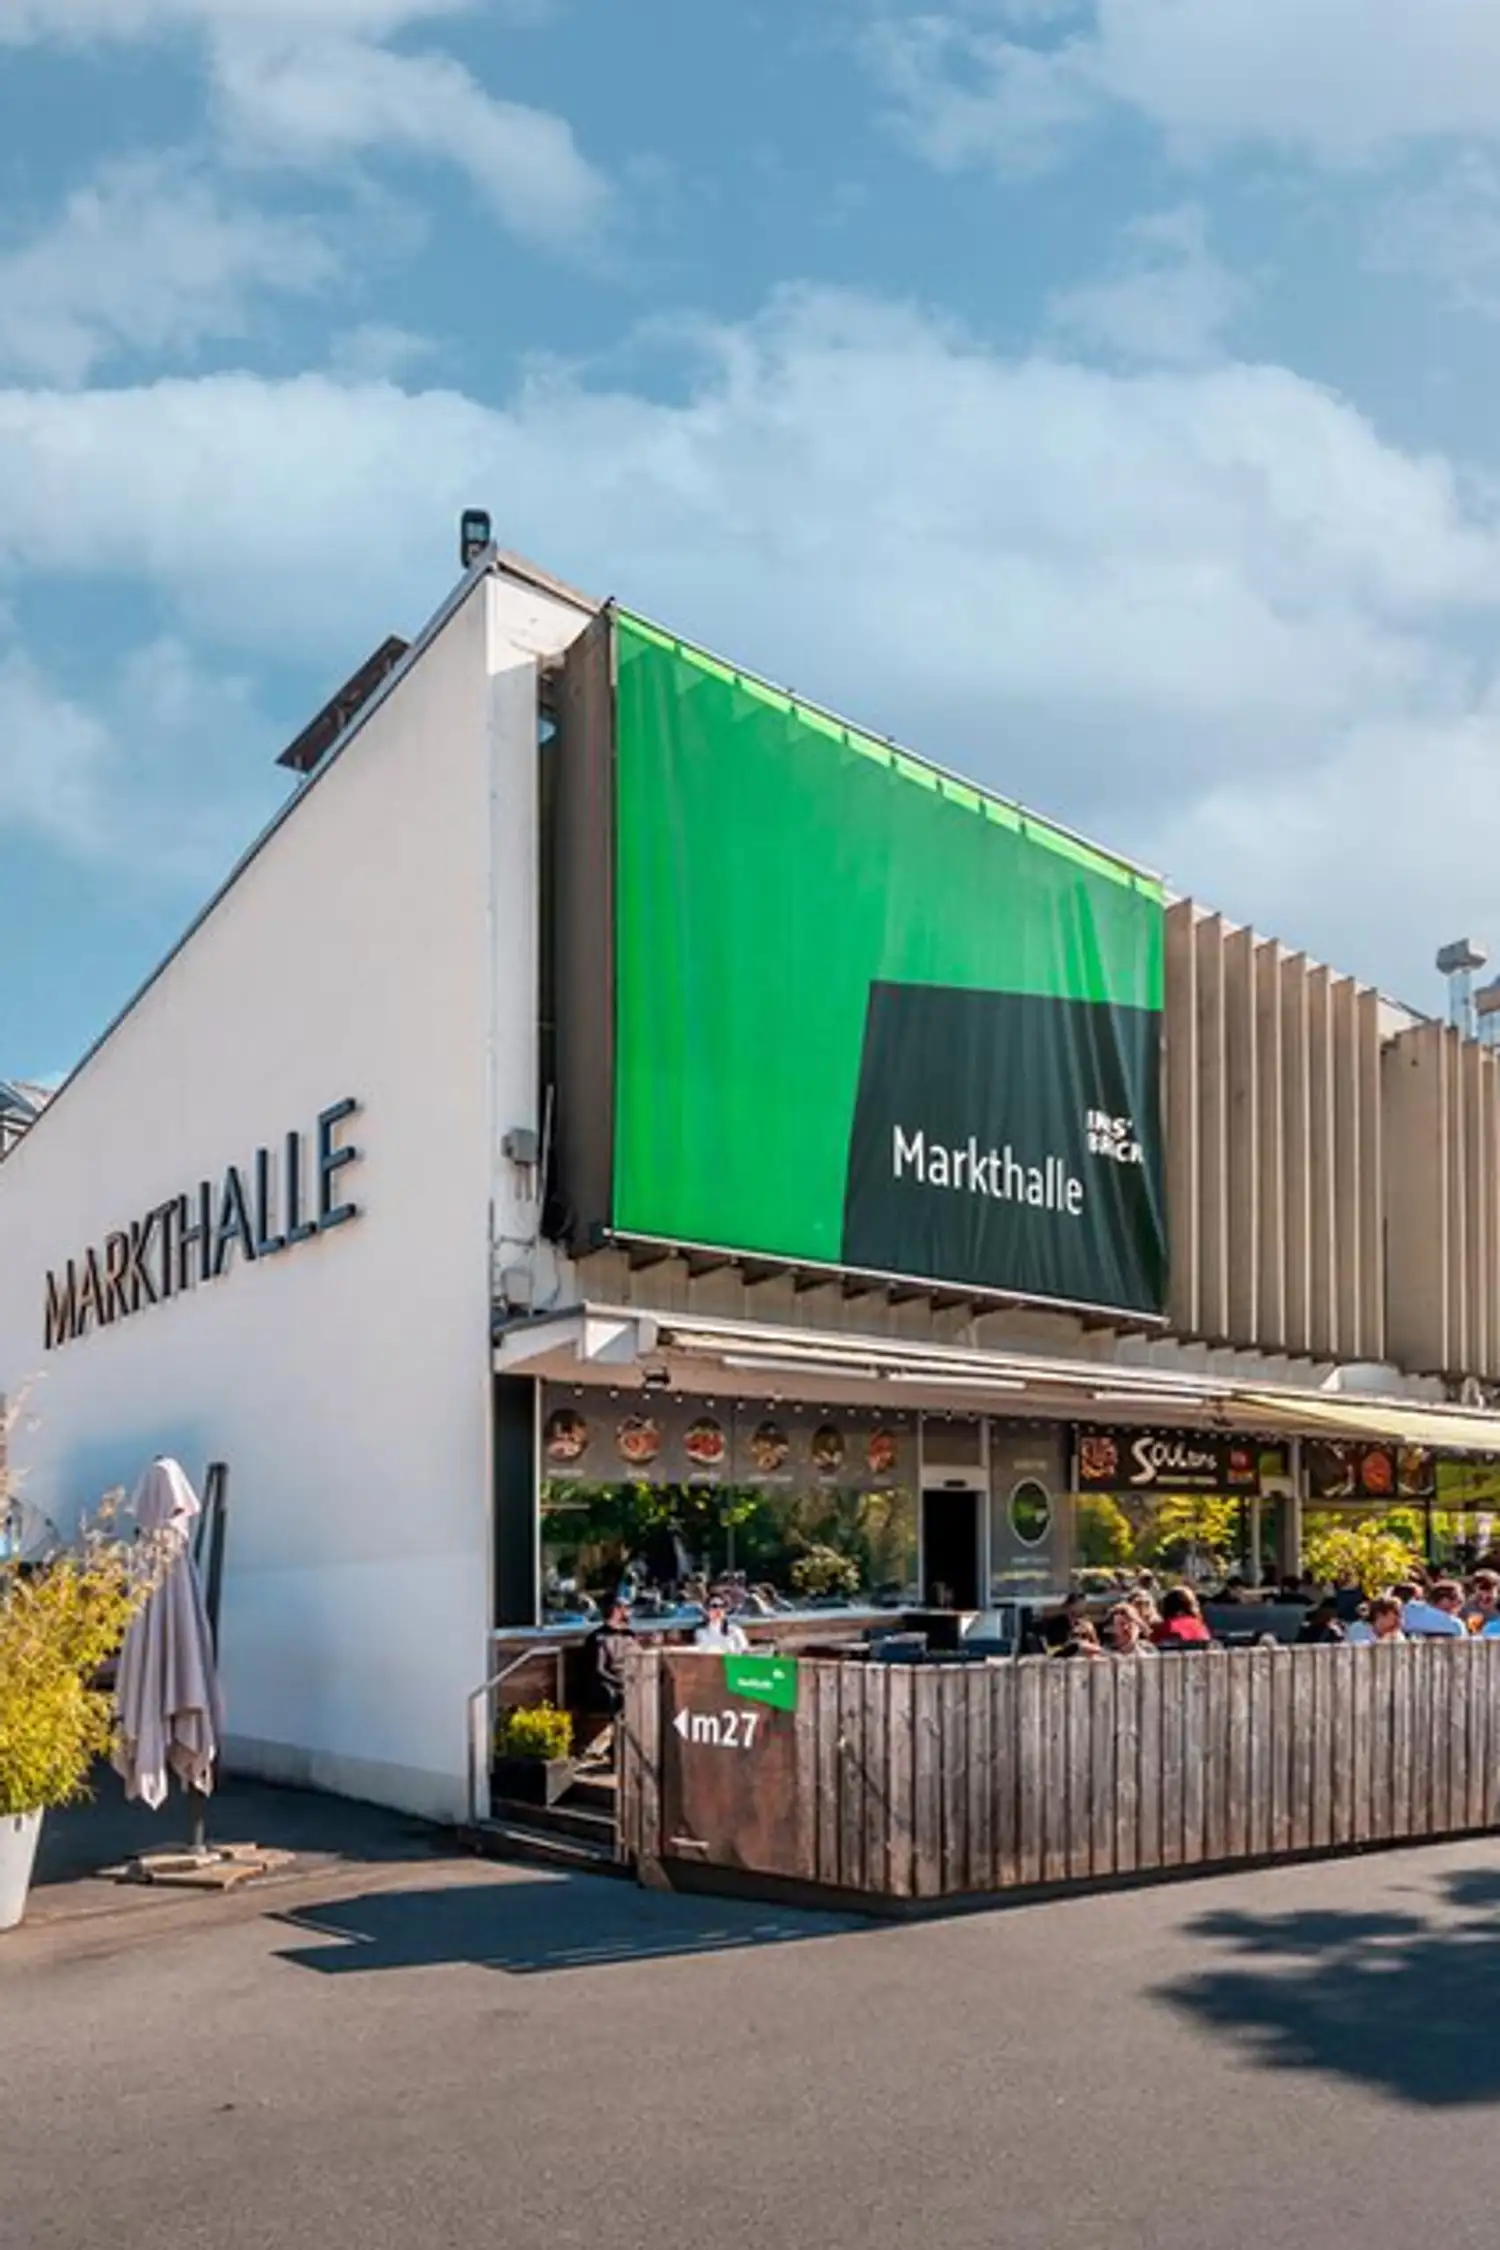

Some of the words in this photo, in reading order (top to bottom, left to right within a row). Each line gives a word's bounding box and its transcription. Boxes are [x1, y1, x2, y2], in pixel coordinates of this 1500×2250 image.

[893, 1124, 1083, 1215] Markthalle
[44, 1097, 356, 1350] MARKTHALLE
[691, 1709, 760, 1749] m27
